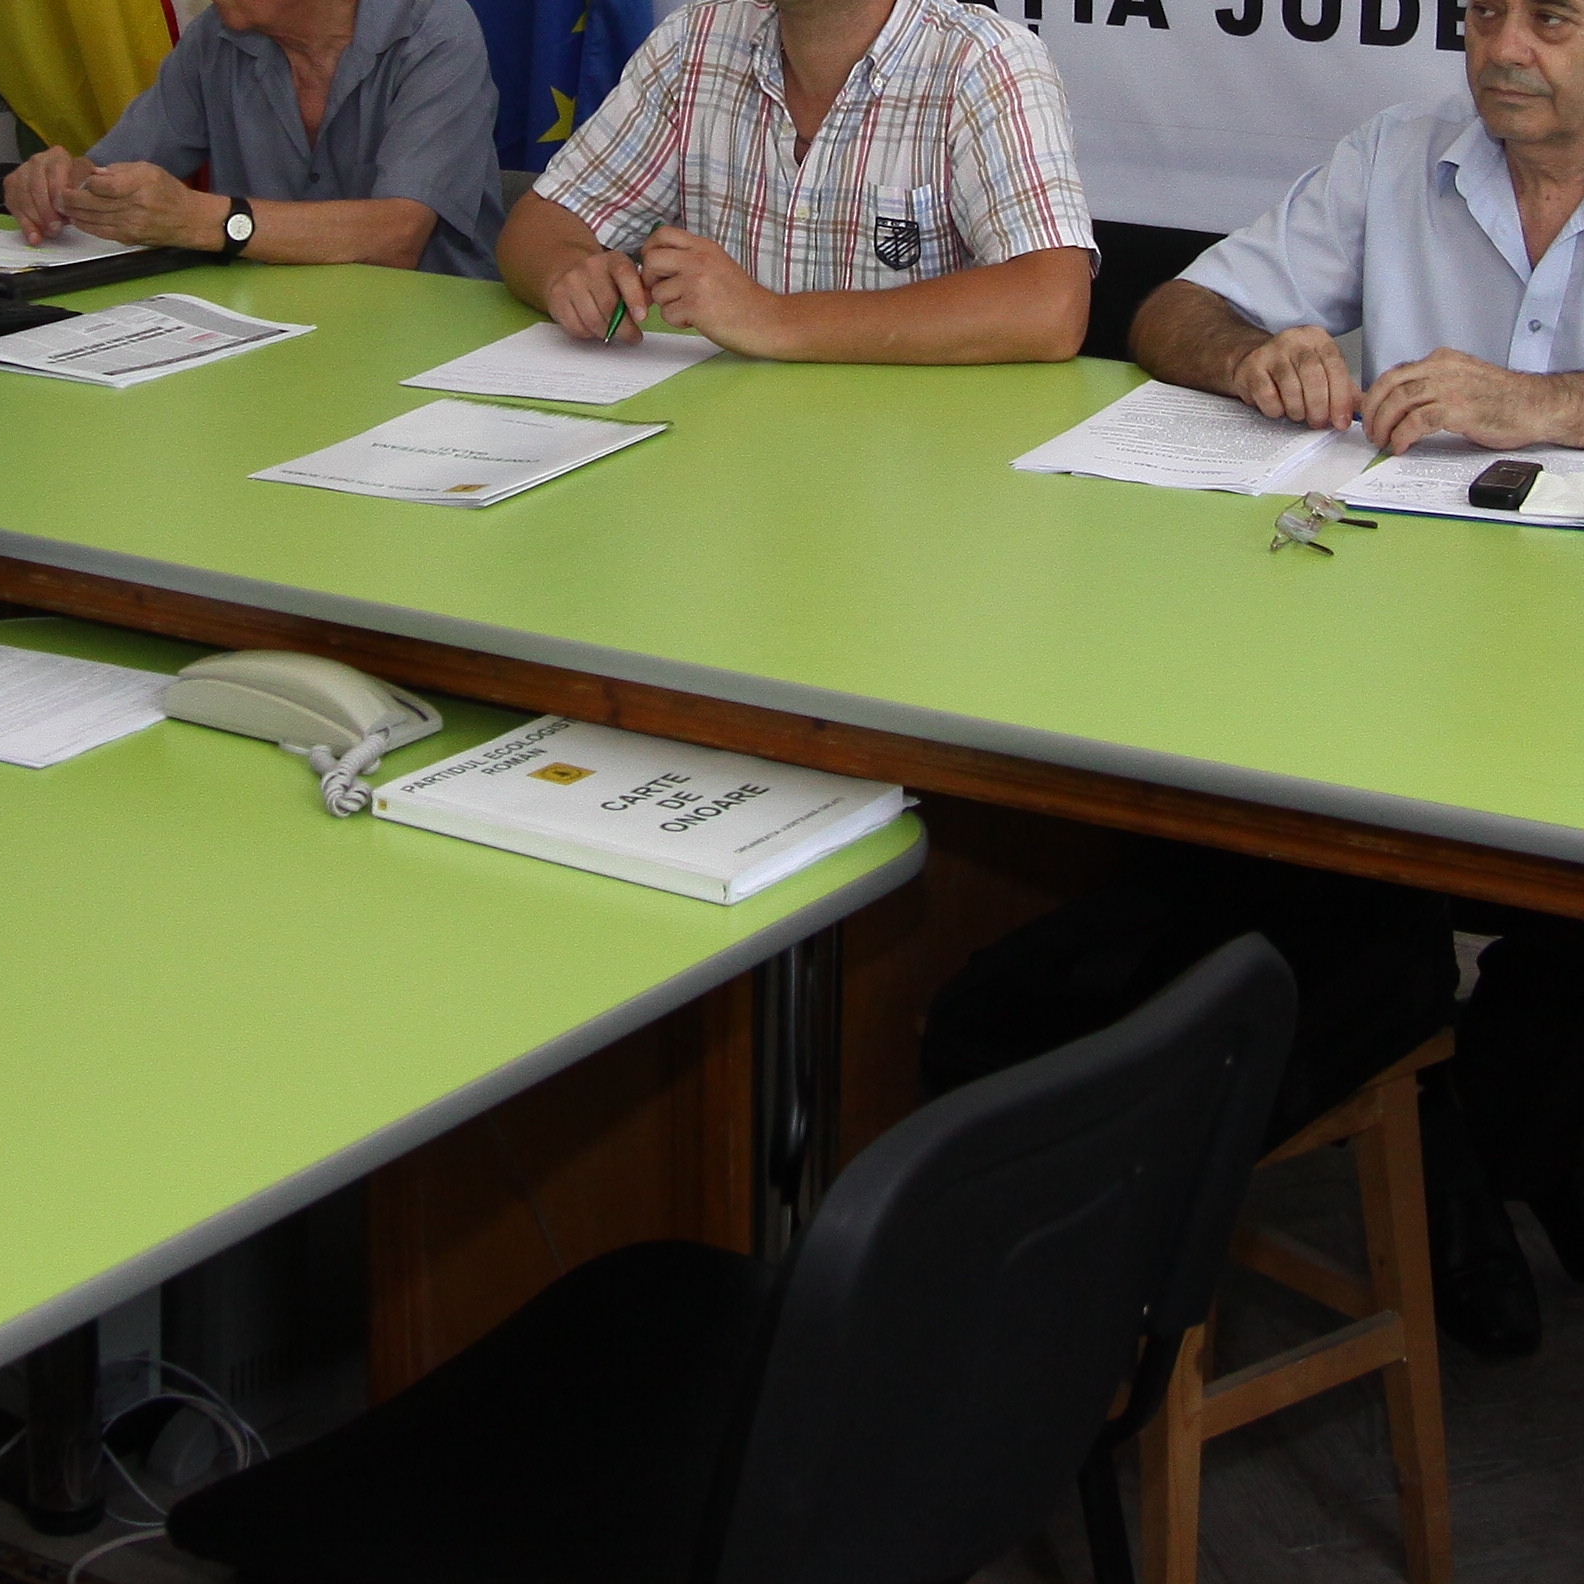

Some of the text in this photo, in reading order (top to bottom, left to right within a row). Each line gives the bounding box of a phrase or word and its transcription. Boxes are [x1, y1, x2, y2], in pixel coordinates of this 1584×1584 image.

[400, 717, 579, 795] PARTIDUL ECOLOGIST
[600, 772, 691, 812] CARTE
[655, 789, 704, 810] DE
[659, 783, 771, 834] ONOARE
